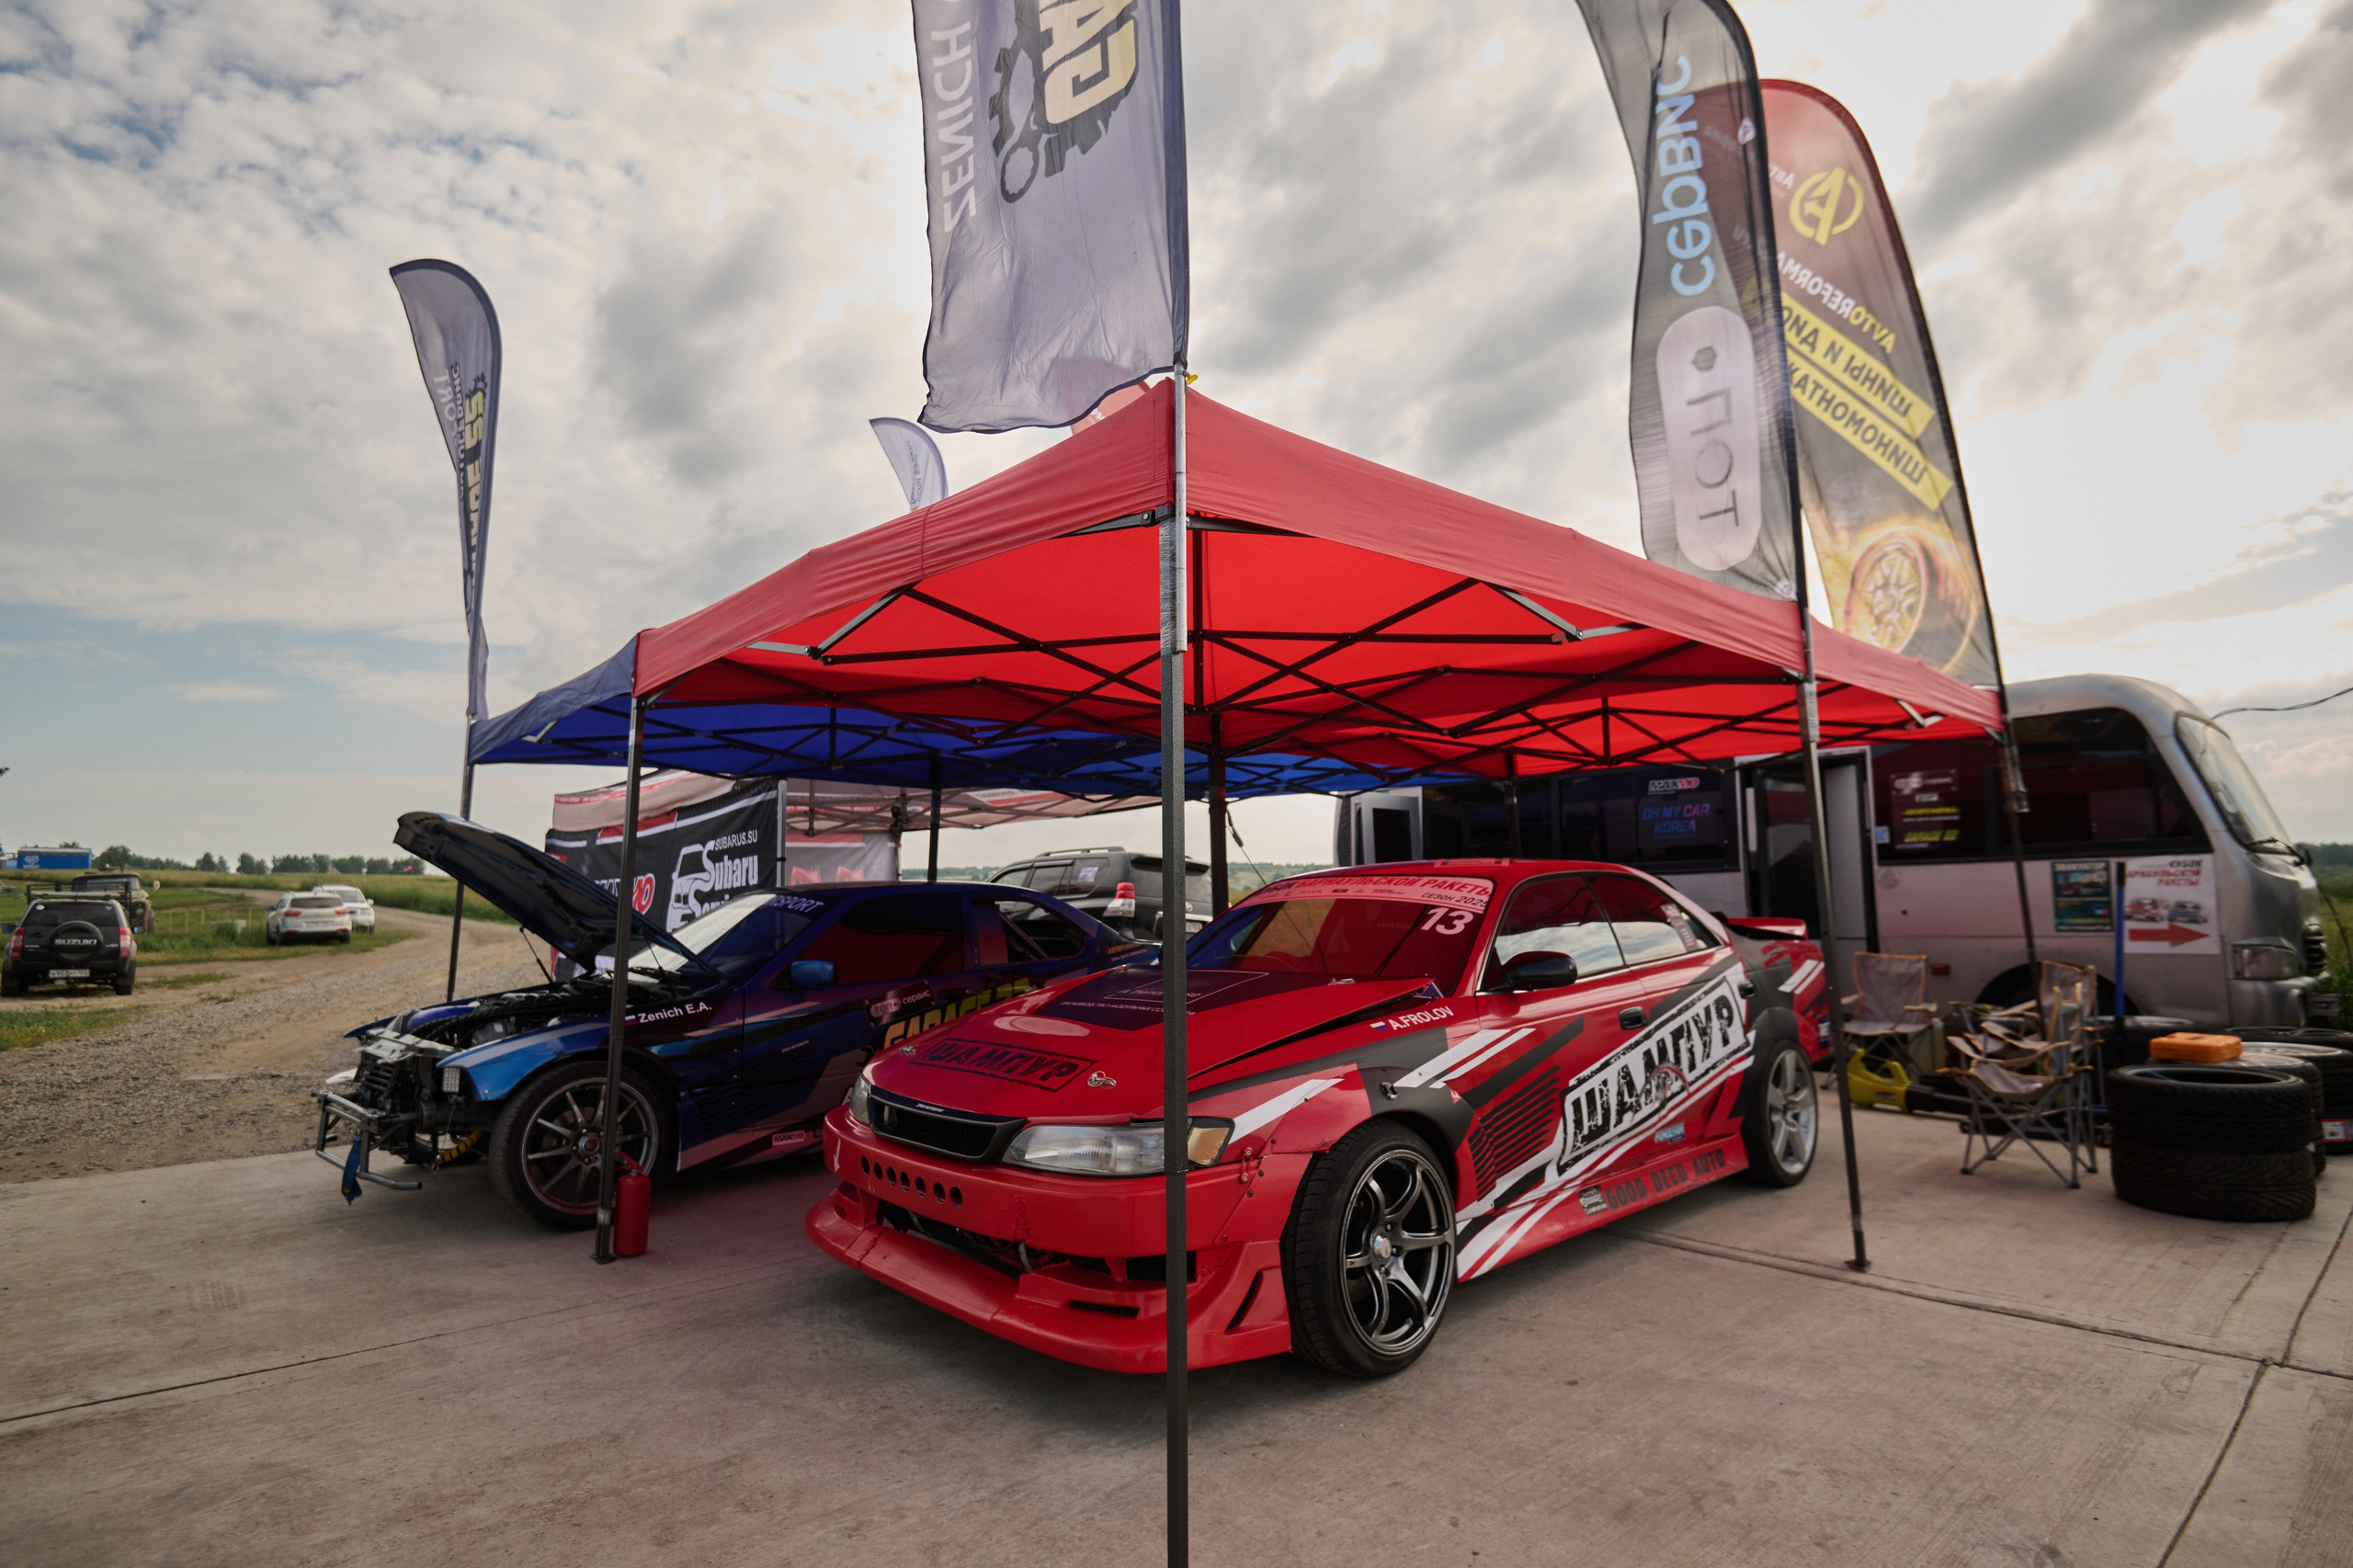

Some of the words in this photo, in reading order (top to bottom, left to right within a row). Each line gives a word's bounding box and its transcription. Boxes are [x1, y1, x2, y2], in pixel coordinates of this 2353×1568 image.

[1642, 807, 1660, 821] OH
[1661, 805, 1682, 819] MY
[1683, 803, 1711, 818] CAR
[1654, 819, 1697, 835] KOREA
[714, 829, 758, 851] SUBARUS.SU
[702, 840, 758, 892] Subaru
[1421, 907, 1474, 936] 13
[902, 989, 931, 1004] сервис
[638, 1006, 683, 1024] Zenich
[686, 1001, 713, 1017] E.A.
[1388, 1006, 1455, 1030] A.FROLOV
[925, 1040, 1077, 1082] ШАМПУР
[1570, 994, 1735, 1150] ШАМПУР
[1606, 1178, 1648, 1210] GOOD
[1653, 1164, 1688, 1192] DEED
[1693, 1149, 1725, 1176] AUTO
